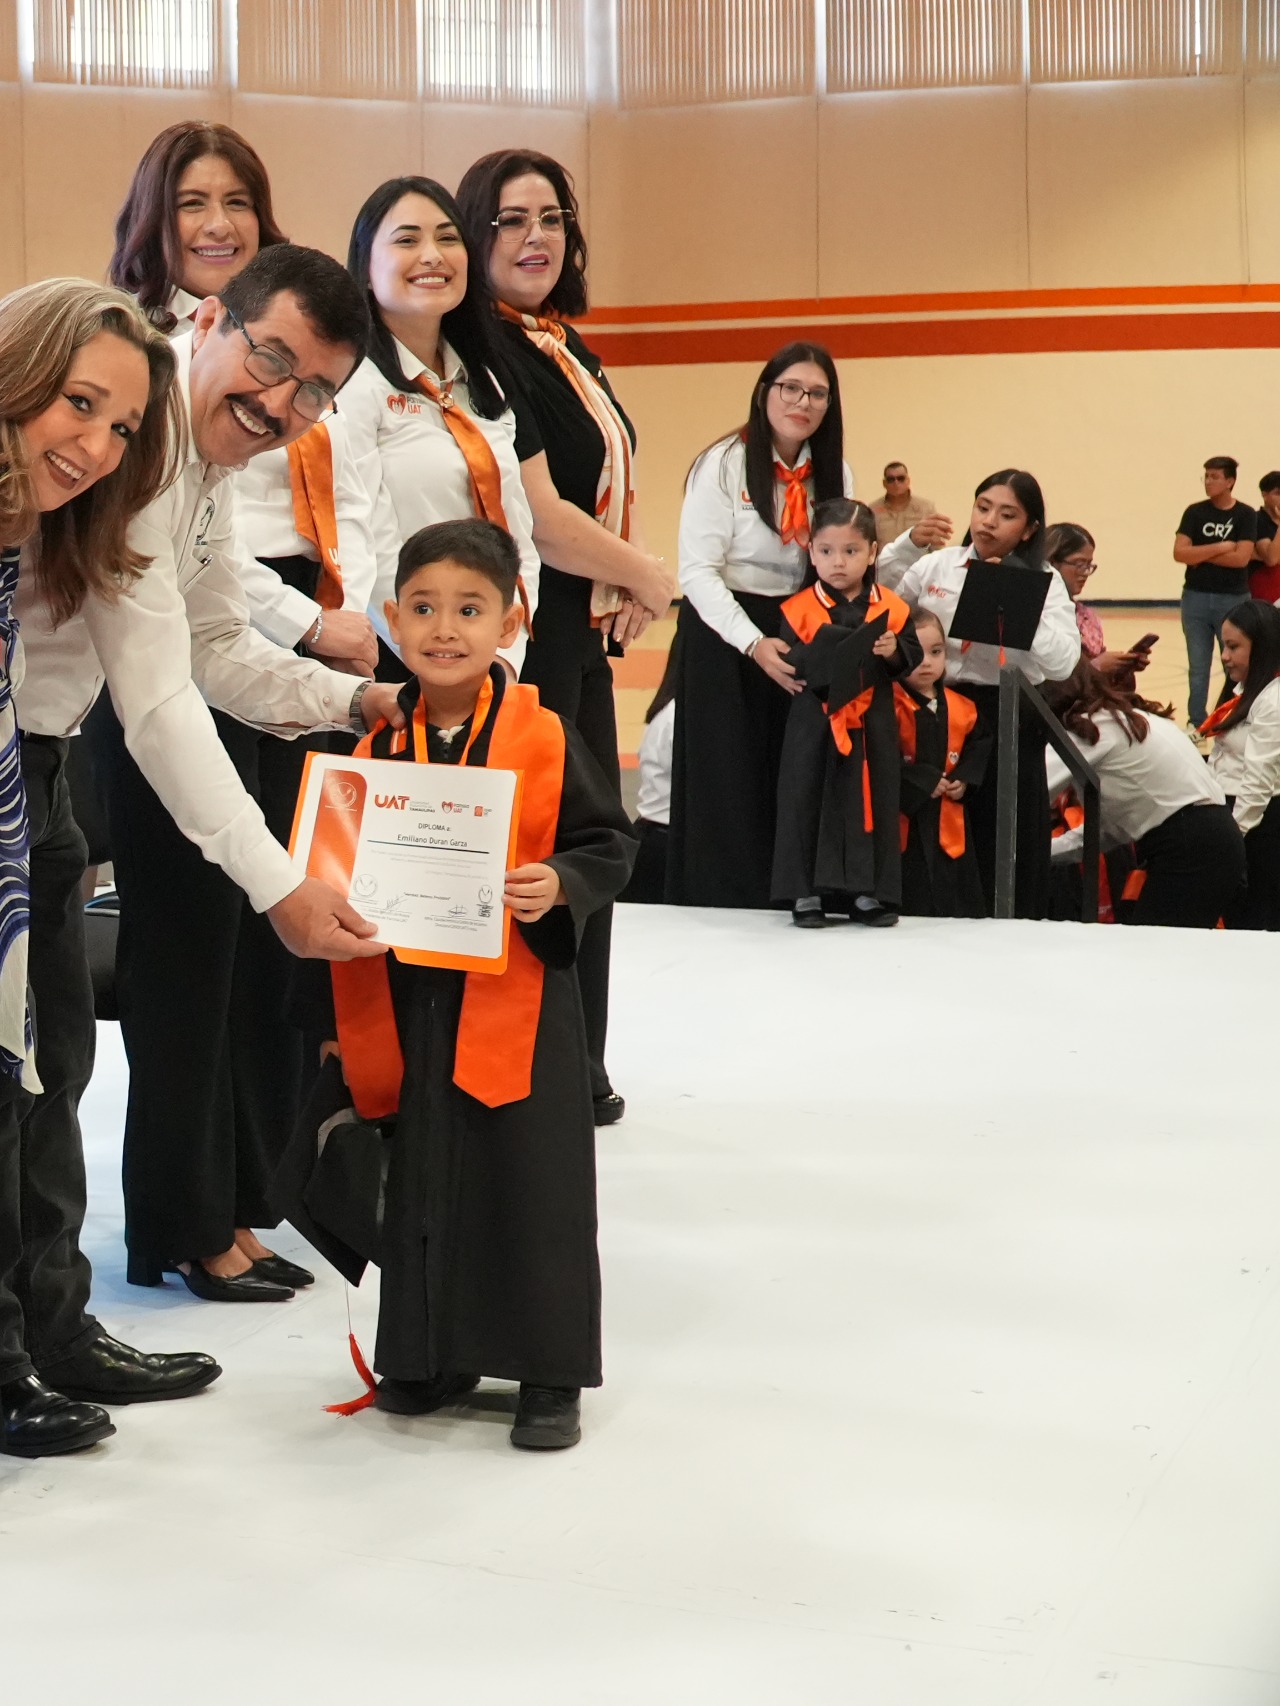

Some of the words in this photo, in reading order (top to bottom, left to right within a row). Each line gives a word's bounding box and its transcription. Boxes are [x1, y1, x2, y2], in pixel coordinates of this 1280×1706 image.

[1202, 517, 1234, 541] CR7
[374, 794, 410, 811] UAT
[418, 822, 446, 832] DIPLOMA
[397, 834, 428, 844] Emiliano
[429, 836, 449, 846] Duran
[450, 838, 468, 848] Garza
